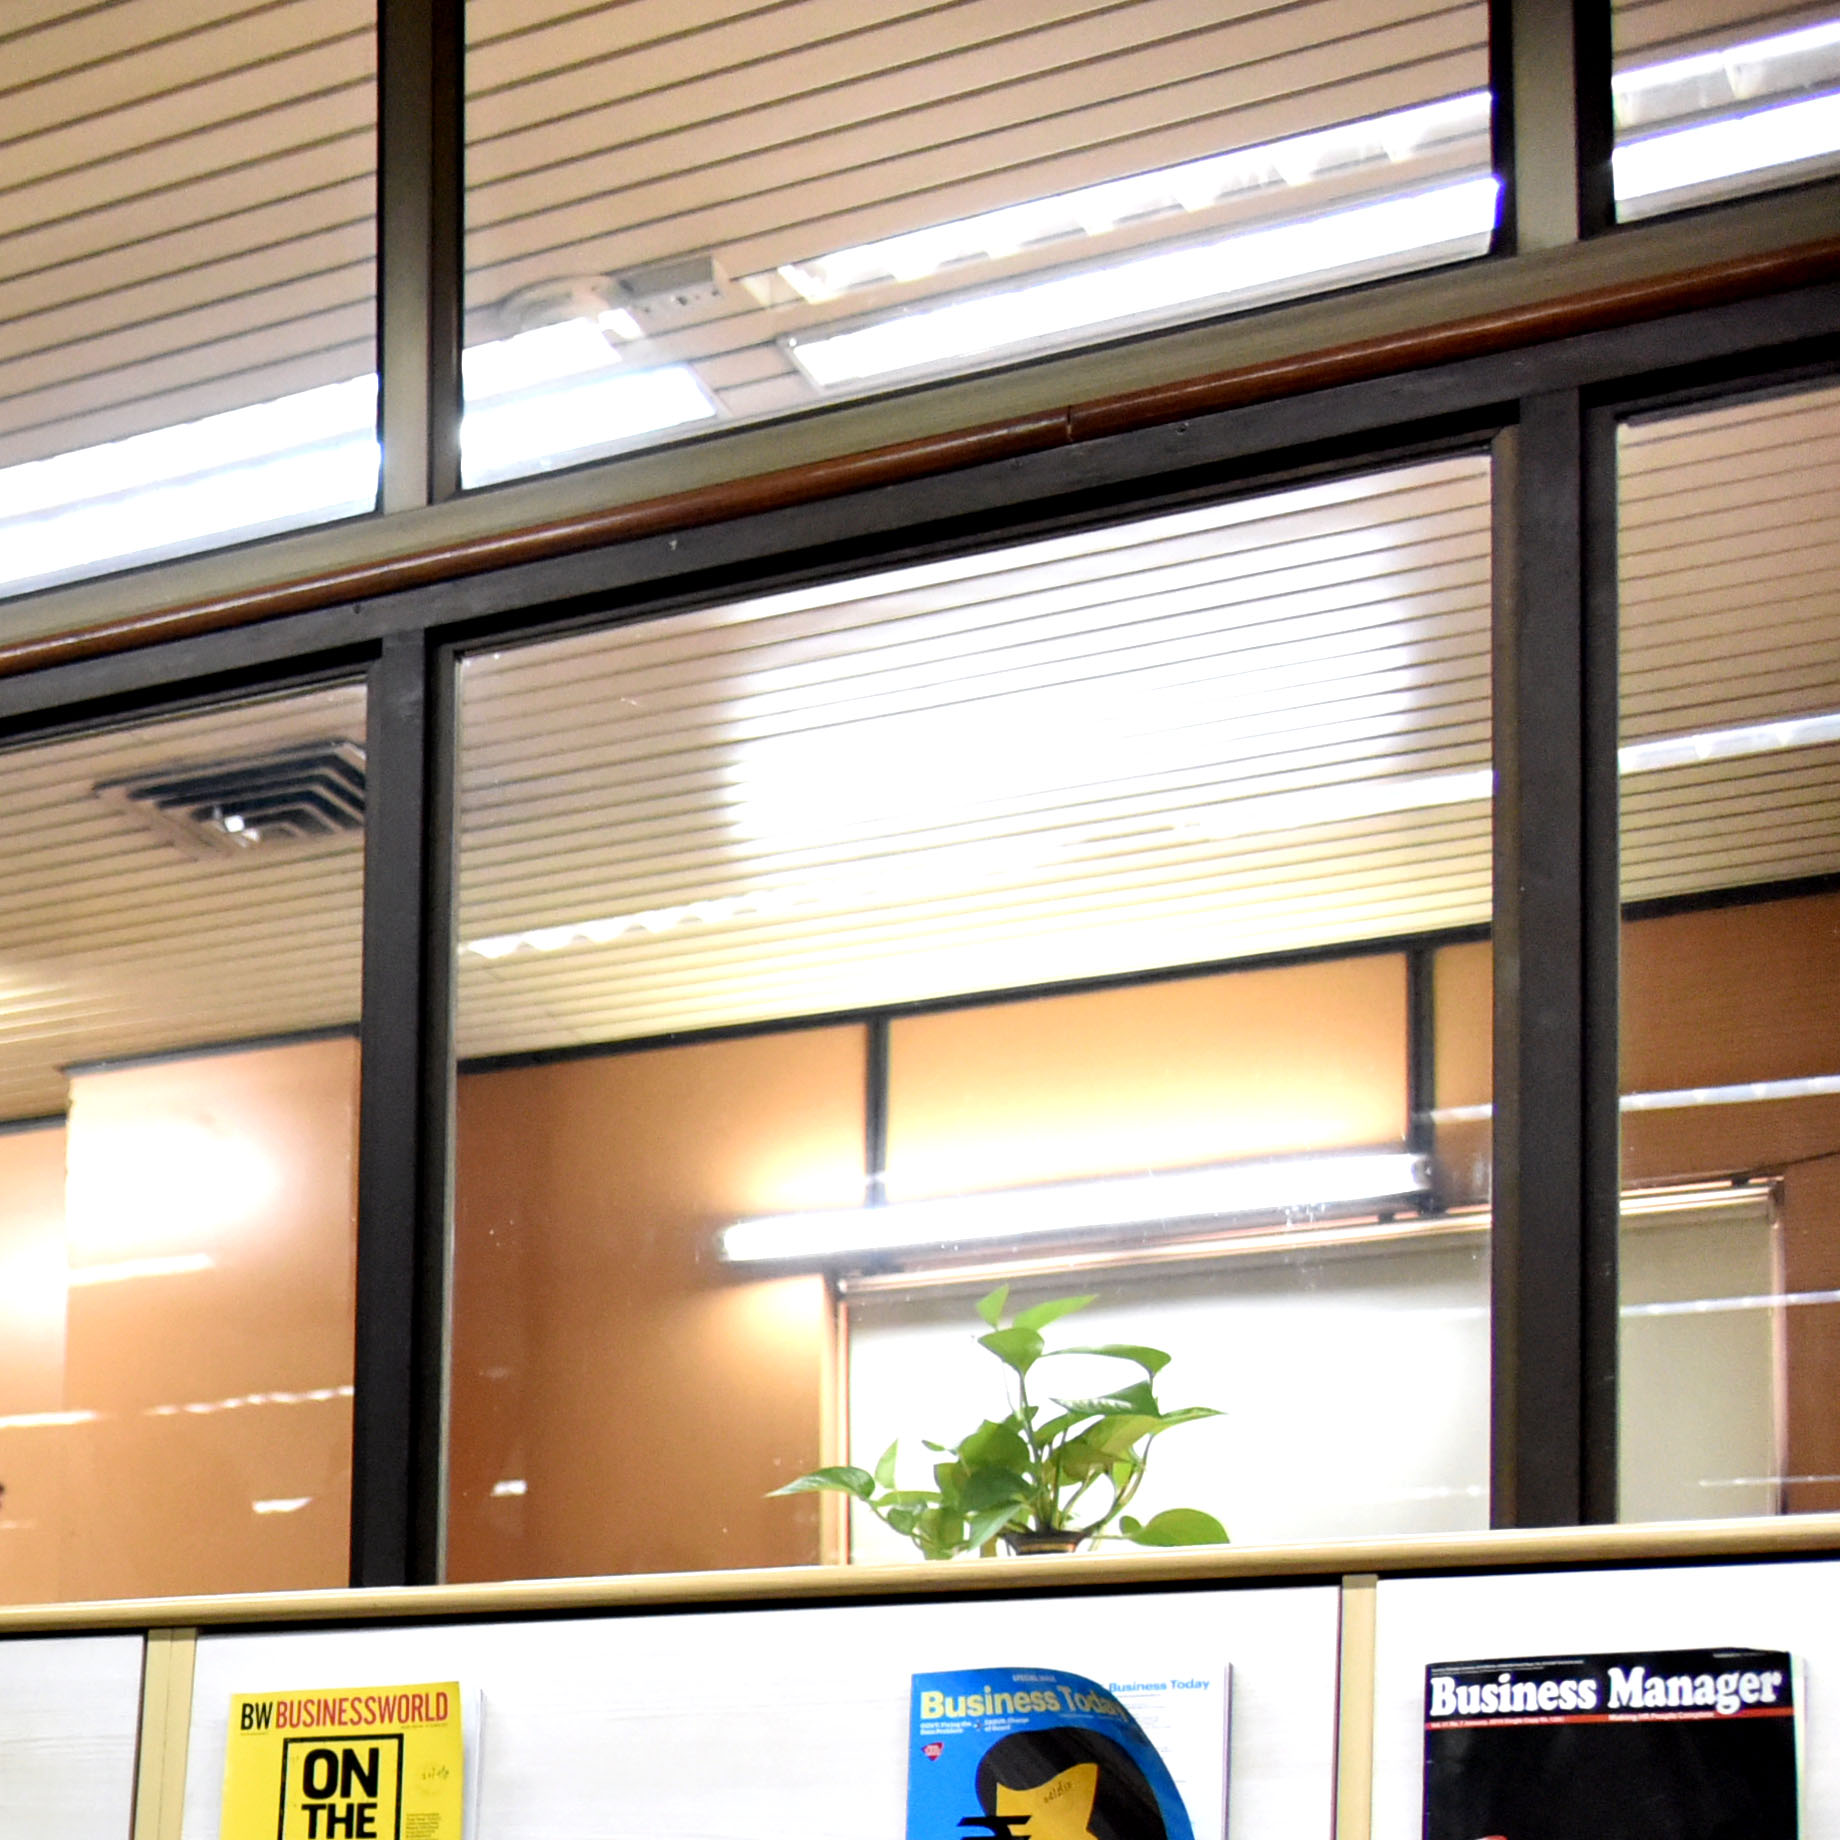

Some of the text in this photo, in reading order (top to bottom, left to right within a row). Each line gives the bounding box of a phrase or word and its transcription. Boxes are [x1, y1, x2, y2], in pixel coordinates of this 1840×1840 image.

[920, 1685, 1060, 1719] Business
[1109, 1679, 1210, 1693] Business Today
[1430, 1666, 1783, 1716] Business Manager
[241, 1691, 449, 1731] BW BUSINESSWORLD
[303, 1747, 380, 1799] ON
[302, 1803, 377, 1839] THE
